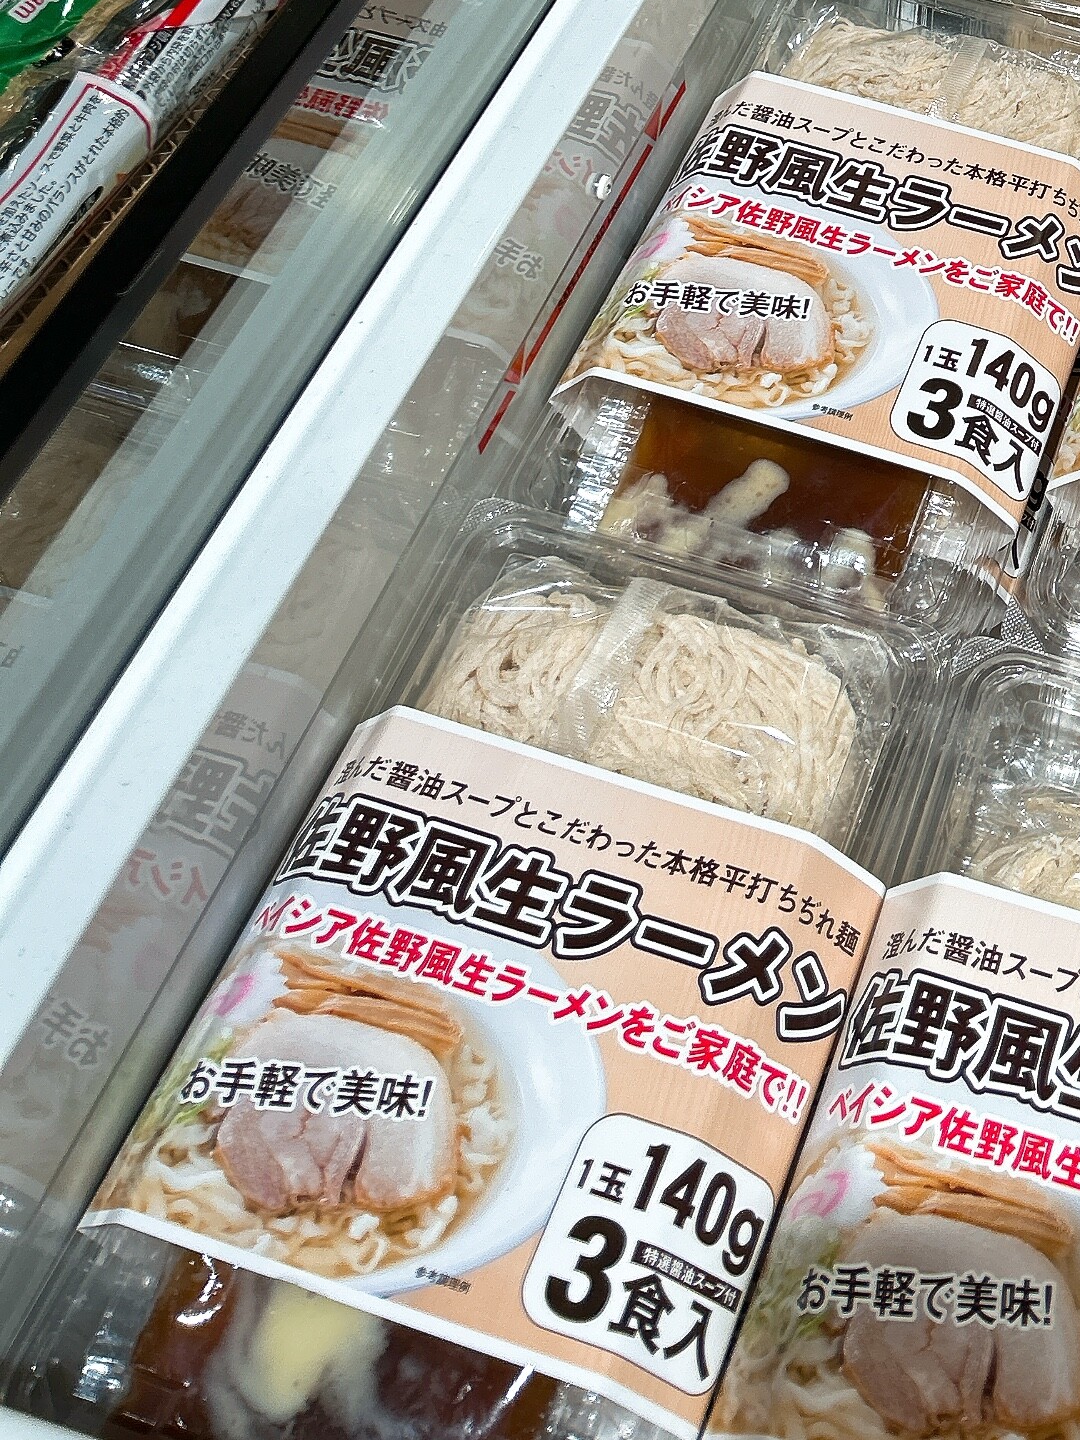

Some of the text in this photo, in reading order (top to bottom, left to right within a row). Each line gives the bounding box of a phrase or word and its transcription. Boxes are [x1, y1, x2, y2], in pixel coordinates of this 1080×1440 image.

[624, 278, 812, 321] お手軽で美味!
[907, 378, 1027, 493] 3食入
[272, 791, 847, 1046] 佐野風生ラーメン
[181, 1058, 434, 1119] お手軽で美味!
[547, 1214, 713, 1383] 3食入
[797, 1269, 1054, 1328] お手軽で美味!
